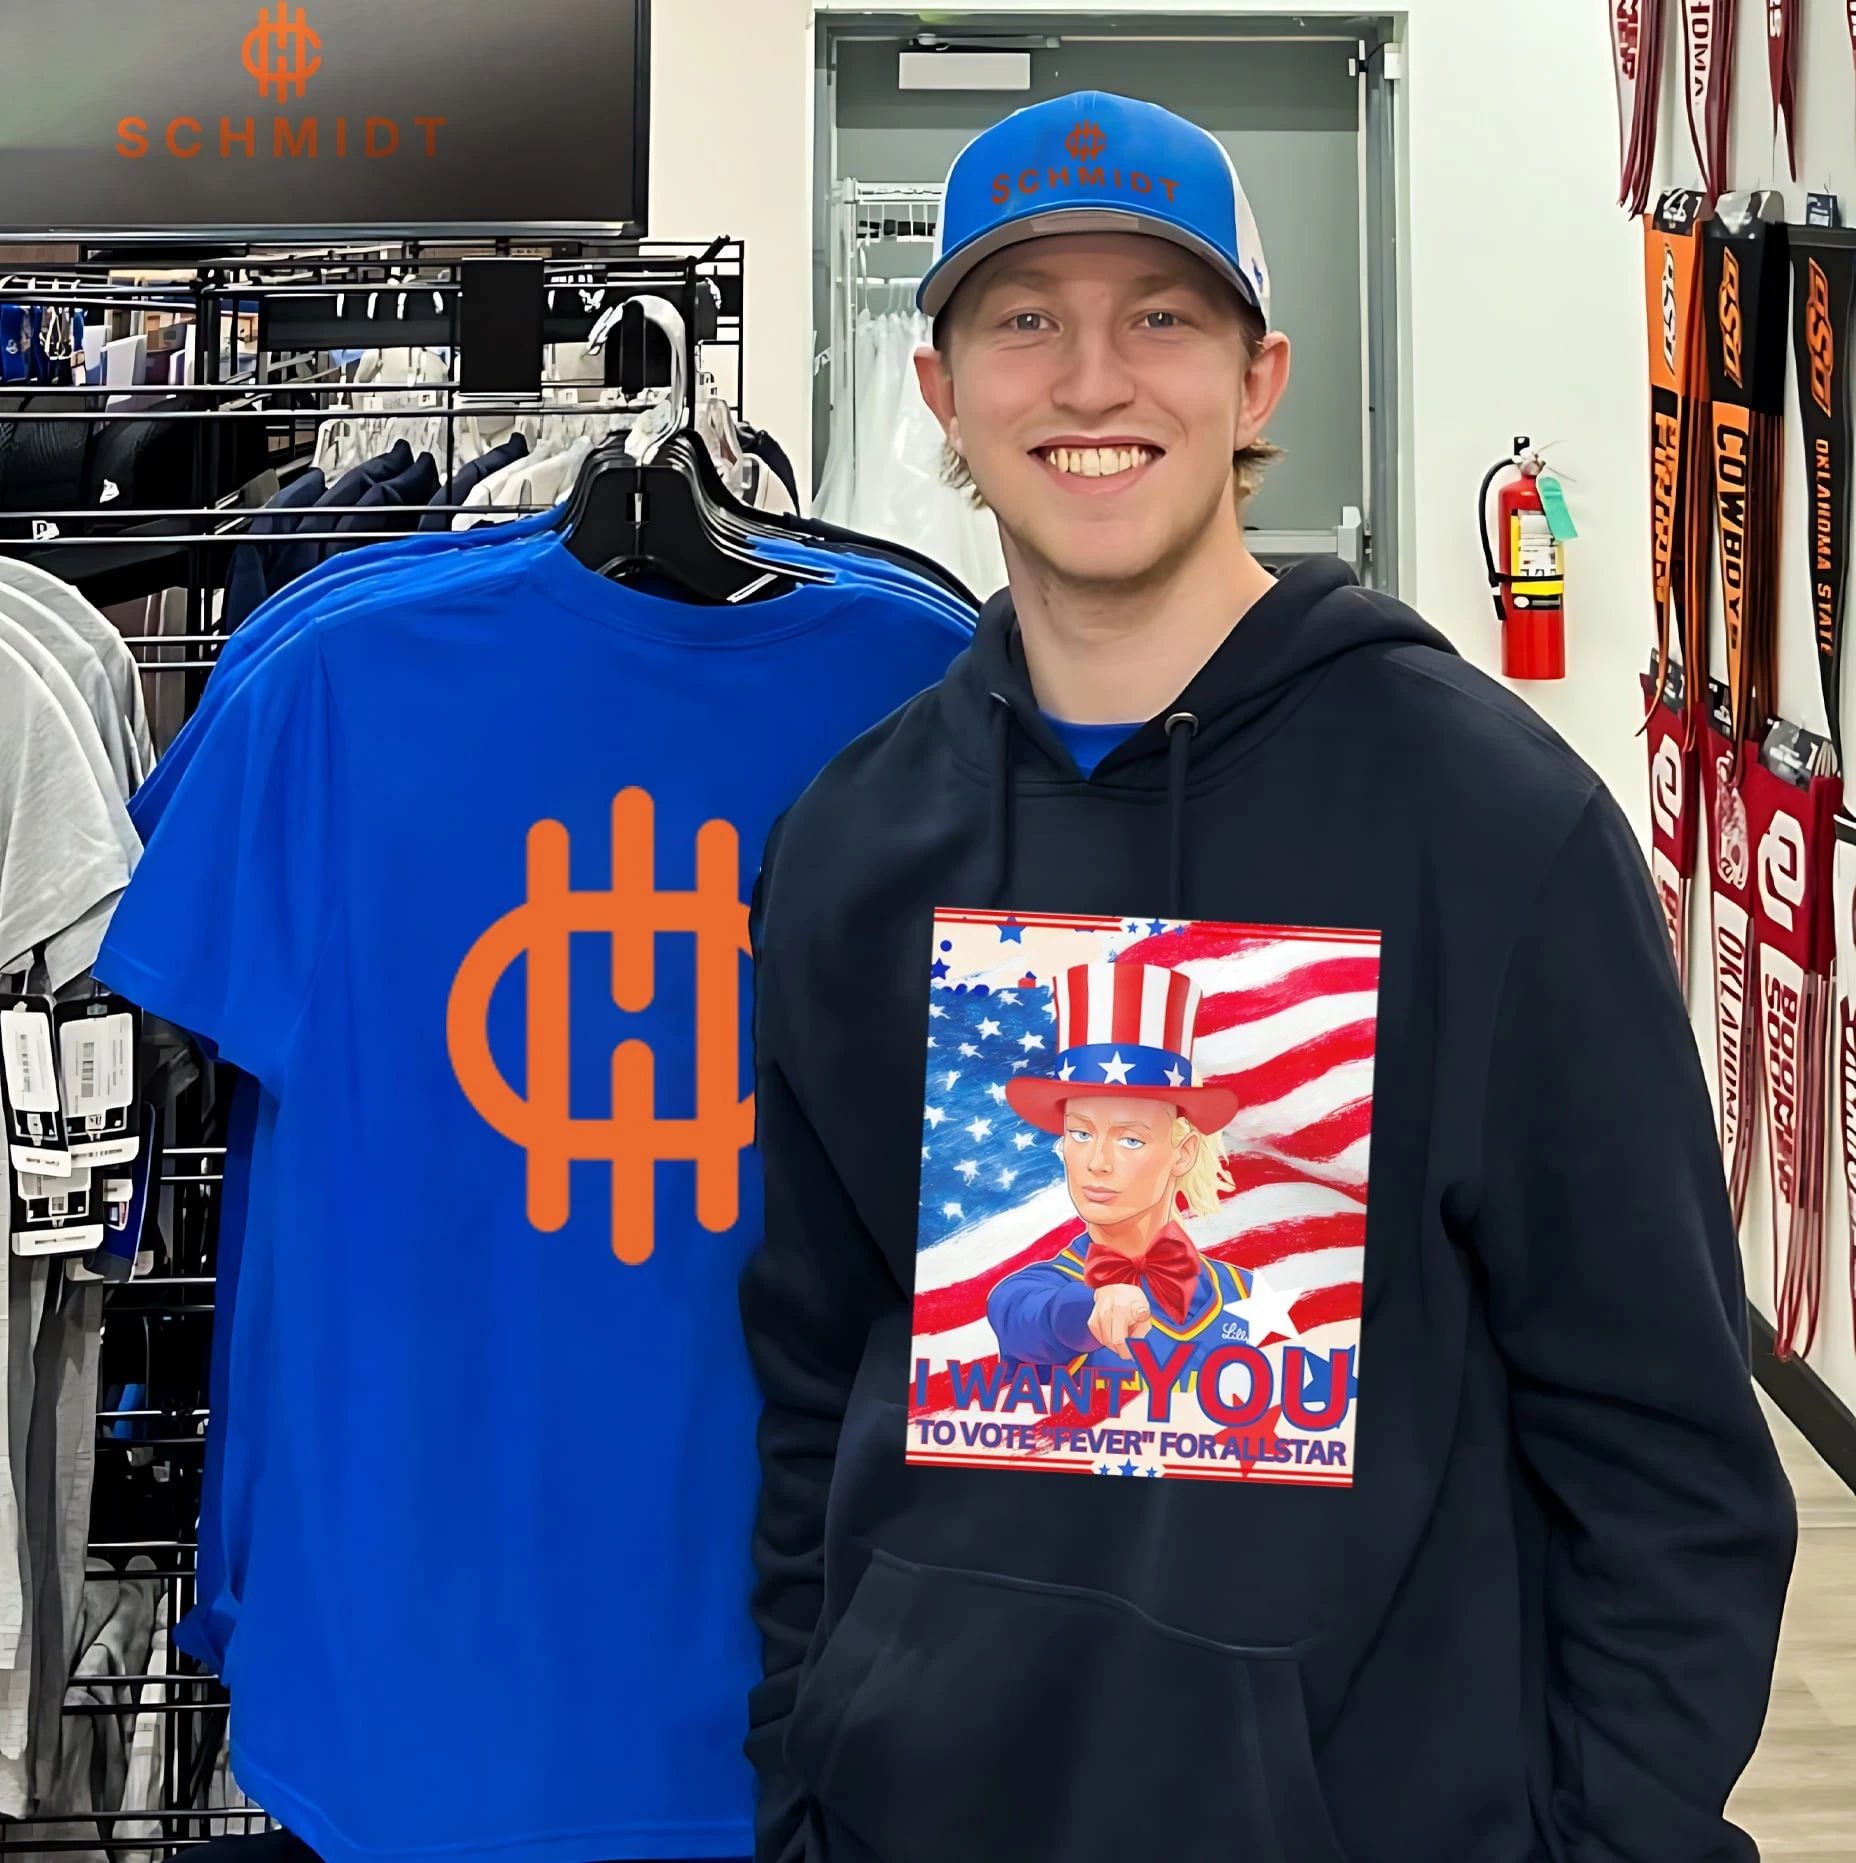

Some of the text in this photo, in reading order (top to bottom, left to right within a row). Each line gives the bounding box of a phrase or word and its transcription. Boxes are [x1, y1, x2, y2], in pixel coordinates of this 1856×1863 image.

[115, 116, 447, 159] SCHMIDT
[991, 165, 1181, 205] SCHMIDT
[1716, 423, 1750, 650] COWBOY
[915, 1336, 1351, 1433] I WANT YOU
[916, 1419, 962, 1446] TO
[961, 1420, 1036, 1451] VOTE
[1159, 1431, 1216, 1459] FOR
[1216, 1437, 1348, 1467] ALLSTAR
